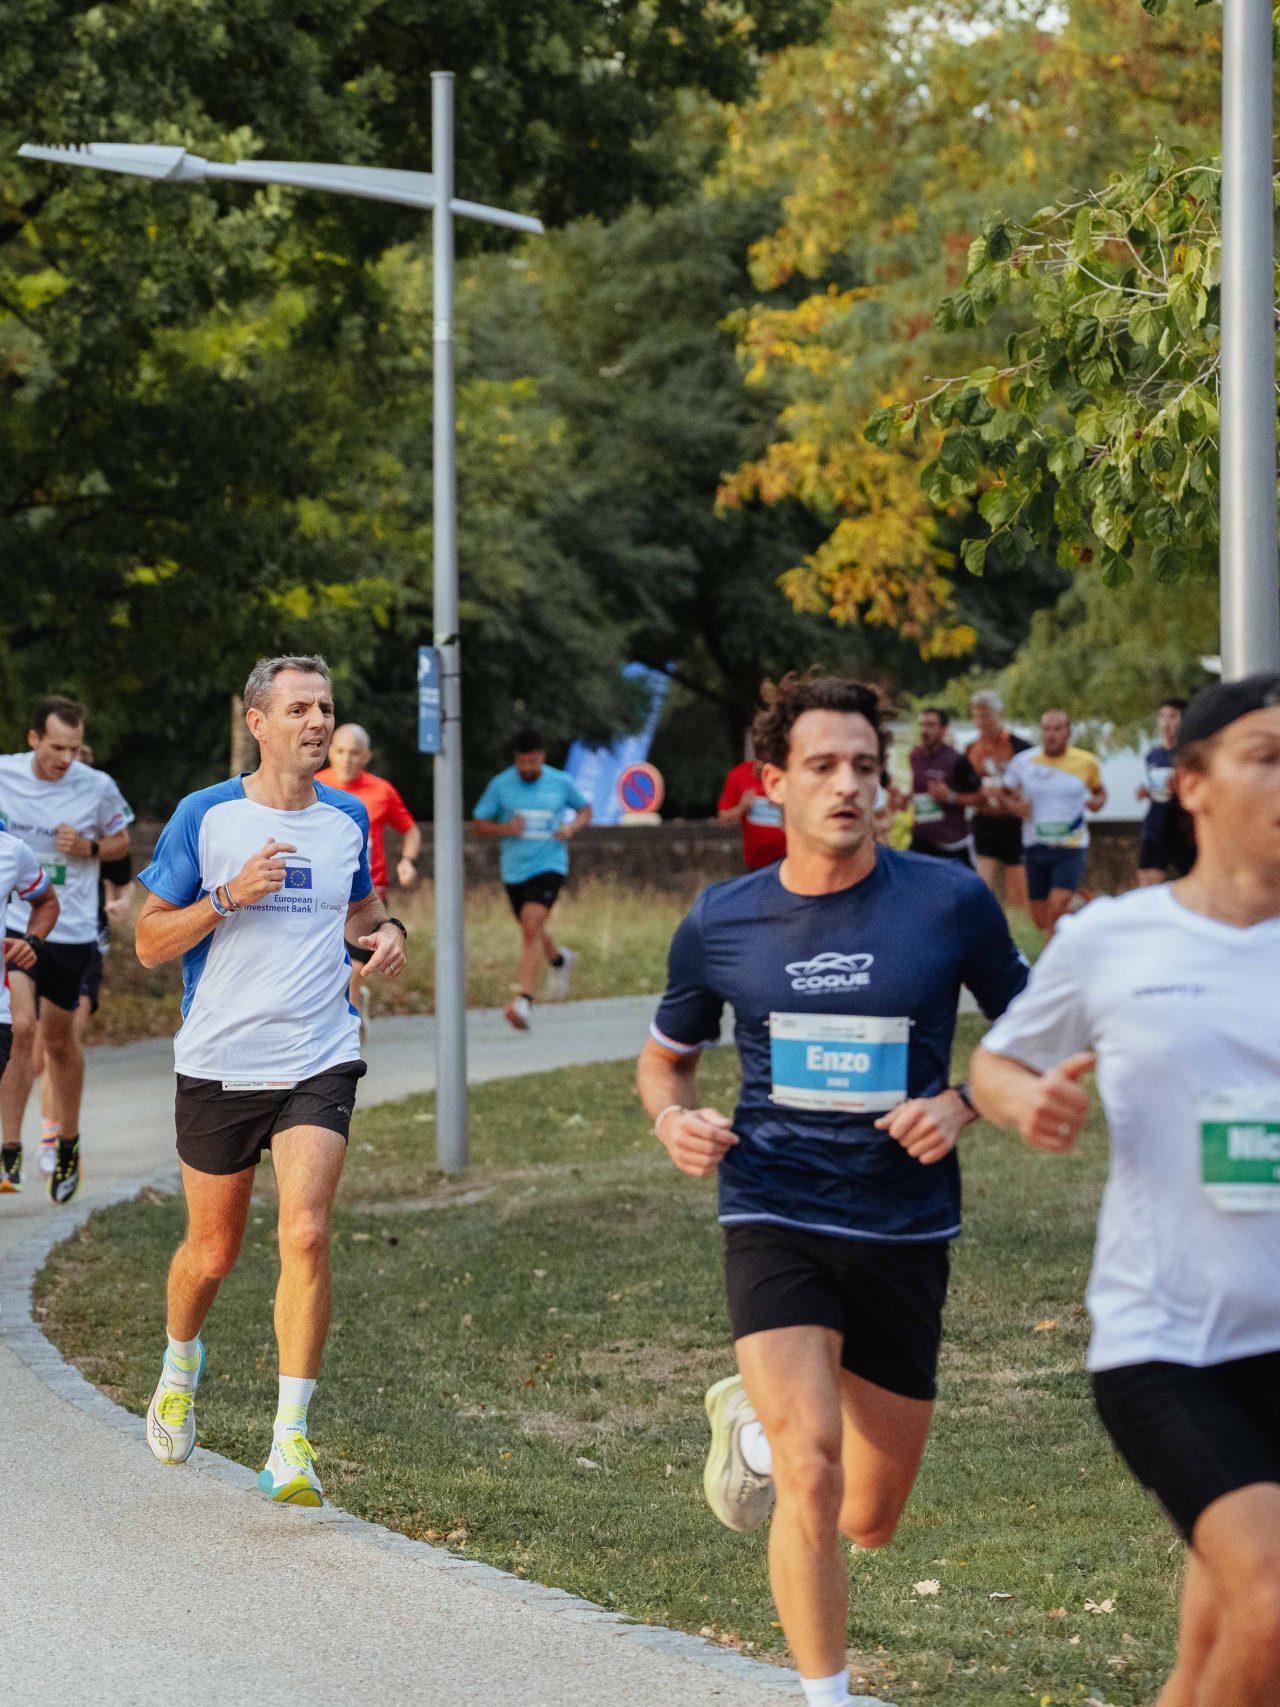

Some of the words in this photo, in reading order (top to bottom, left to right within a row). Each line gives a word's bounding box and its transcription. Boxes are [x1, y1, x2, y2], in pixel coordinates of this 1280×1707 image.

[274, 895, 313, 905] European
[291, 905, 312, 913] Bank
[320, 902, 342, 911] Group
[790, 971, 871, 990] COQUE
[806, 1045, 870, 1073] Enzo
